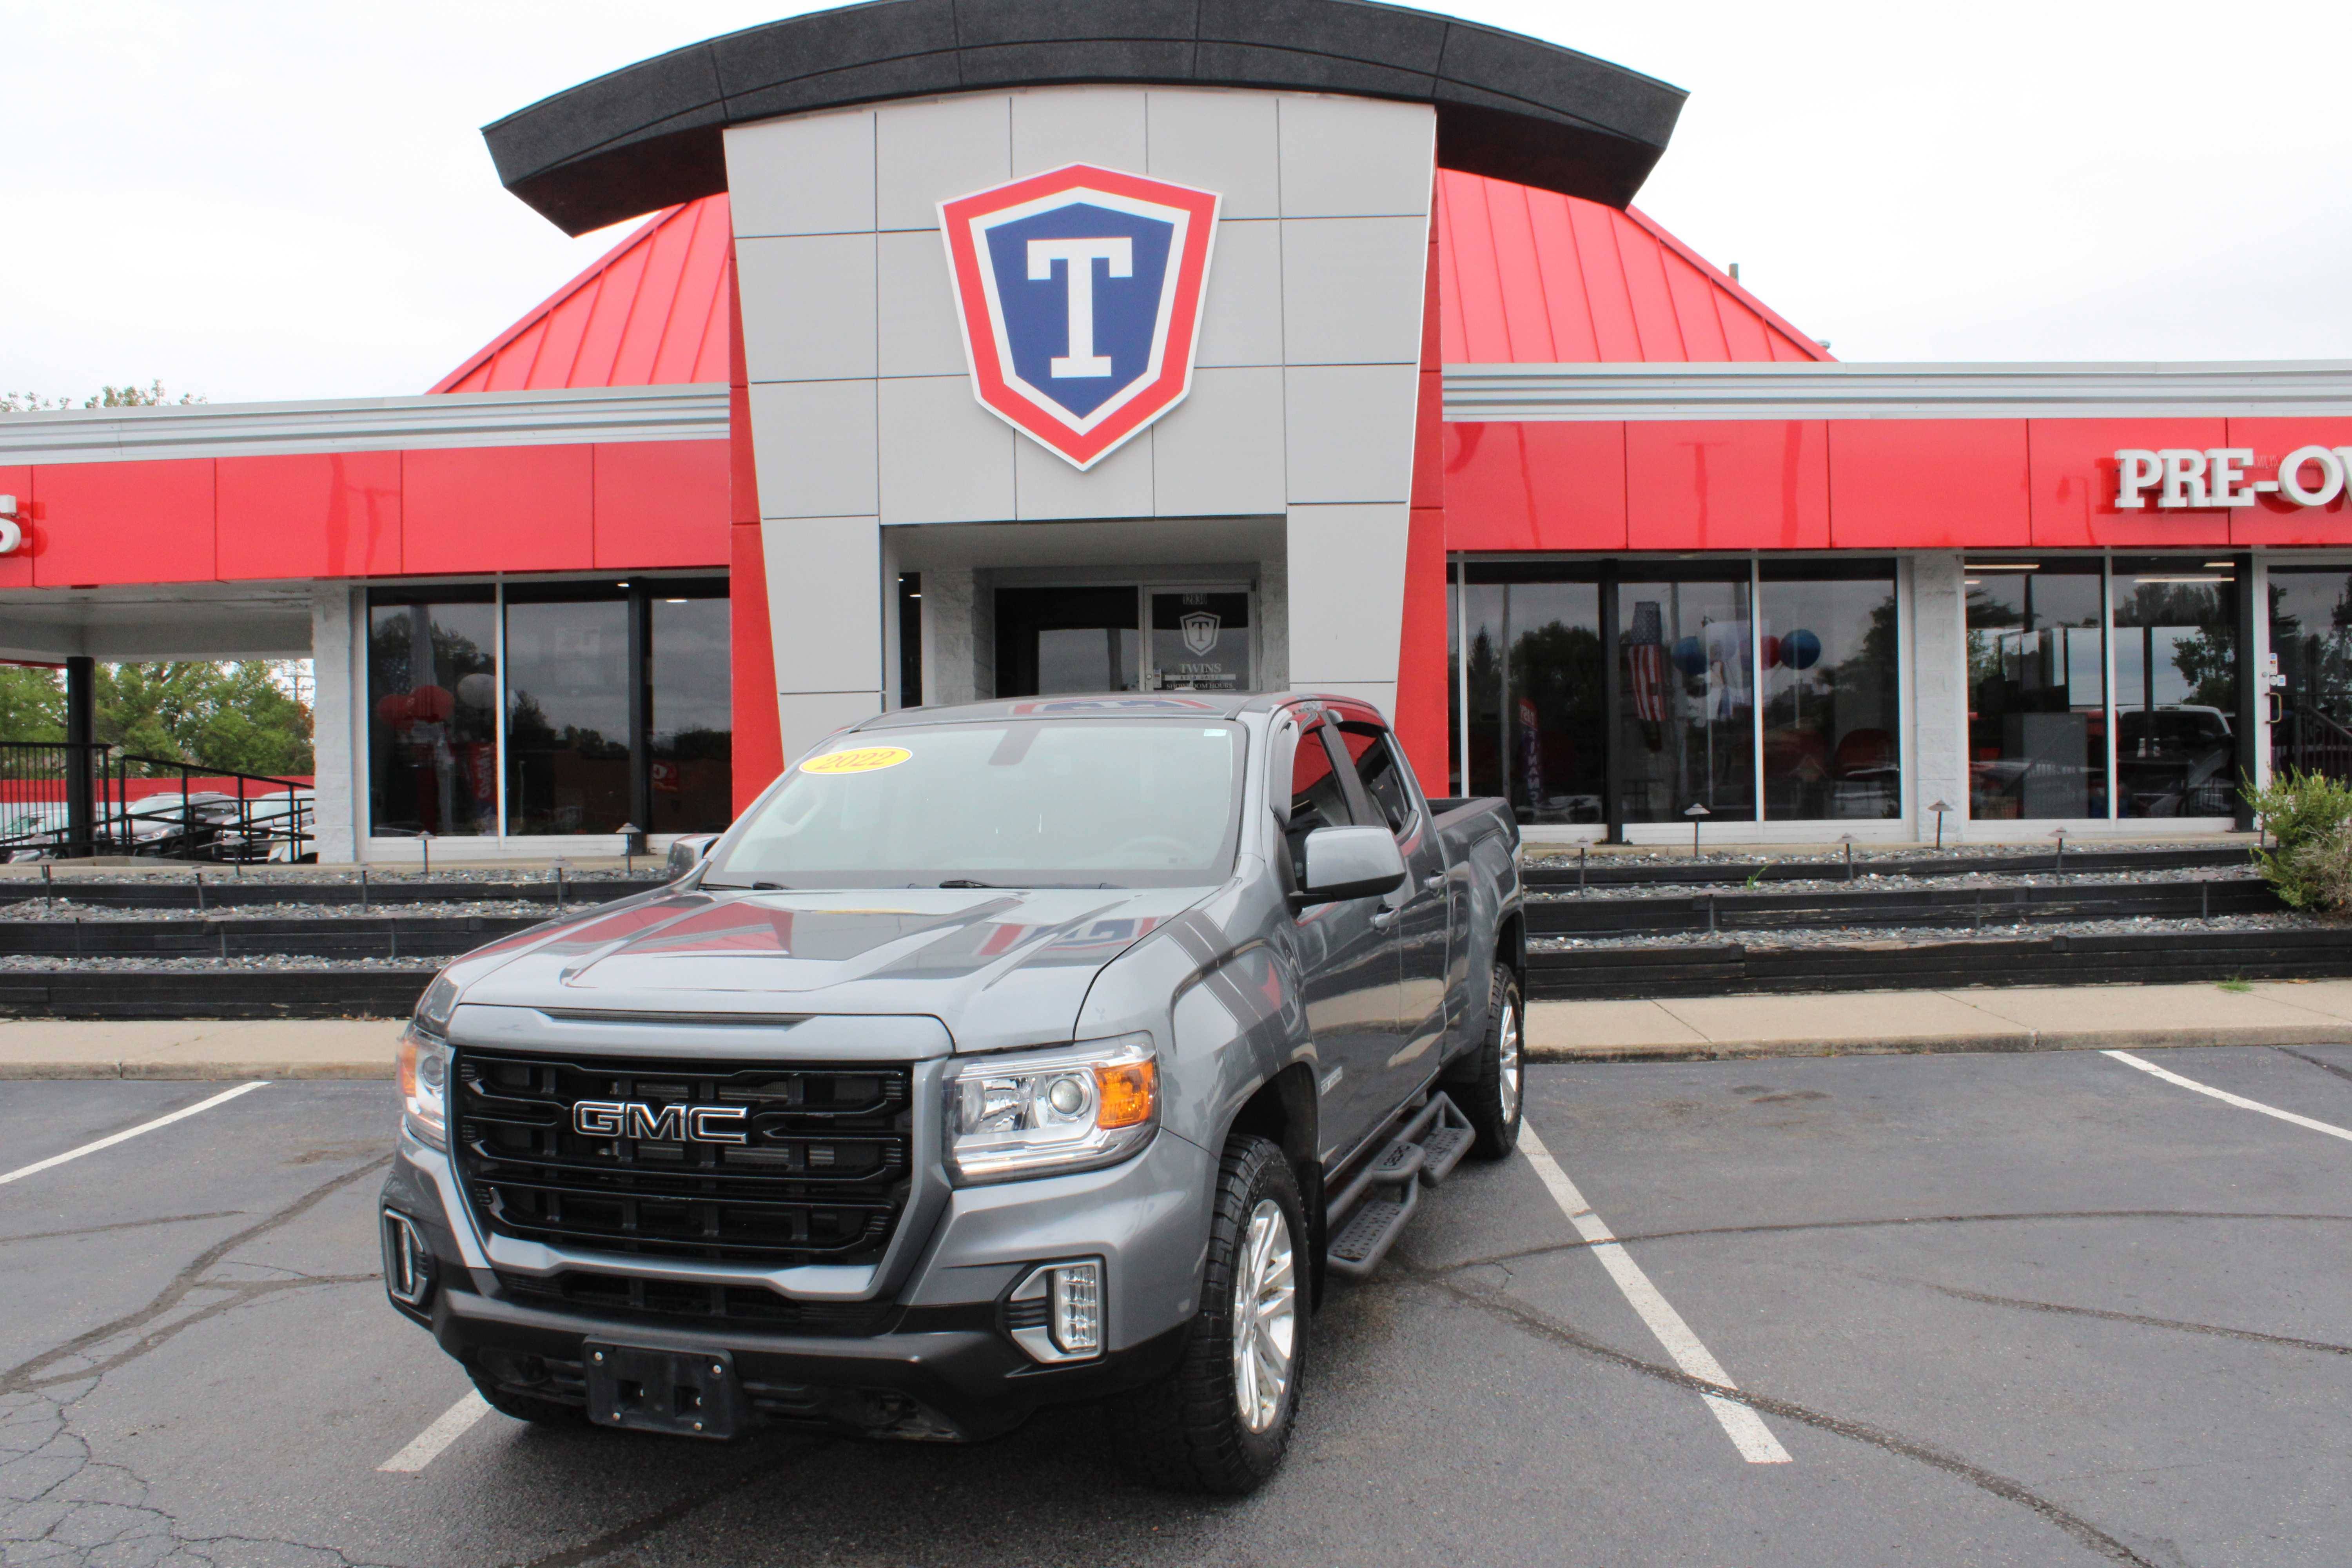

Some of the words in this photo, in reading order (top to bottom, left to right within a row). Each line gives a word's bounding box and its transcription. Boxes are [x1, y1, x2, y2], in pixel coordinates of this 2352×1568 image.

[1027, 237, 1132, 378] T
[2114, 445, 2352, 508] PRE-O
[1192, 621, 1209, 642] T
[1179, 663, 1221, 673] TWINS
[815, 751, 896, 771] 2022
[573, 1100, 747, 1145] GMC
